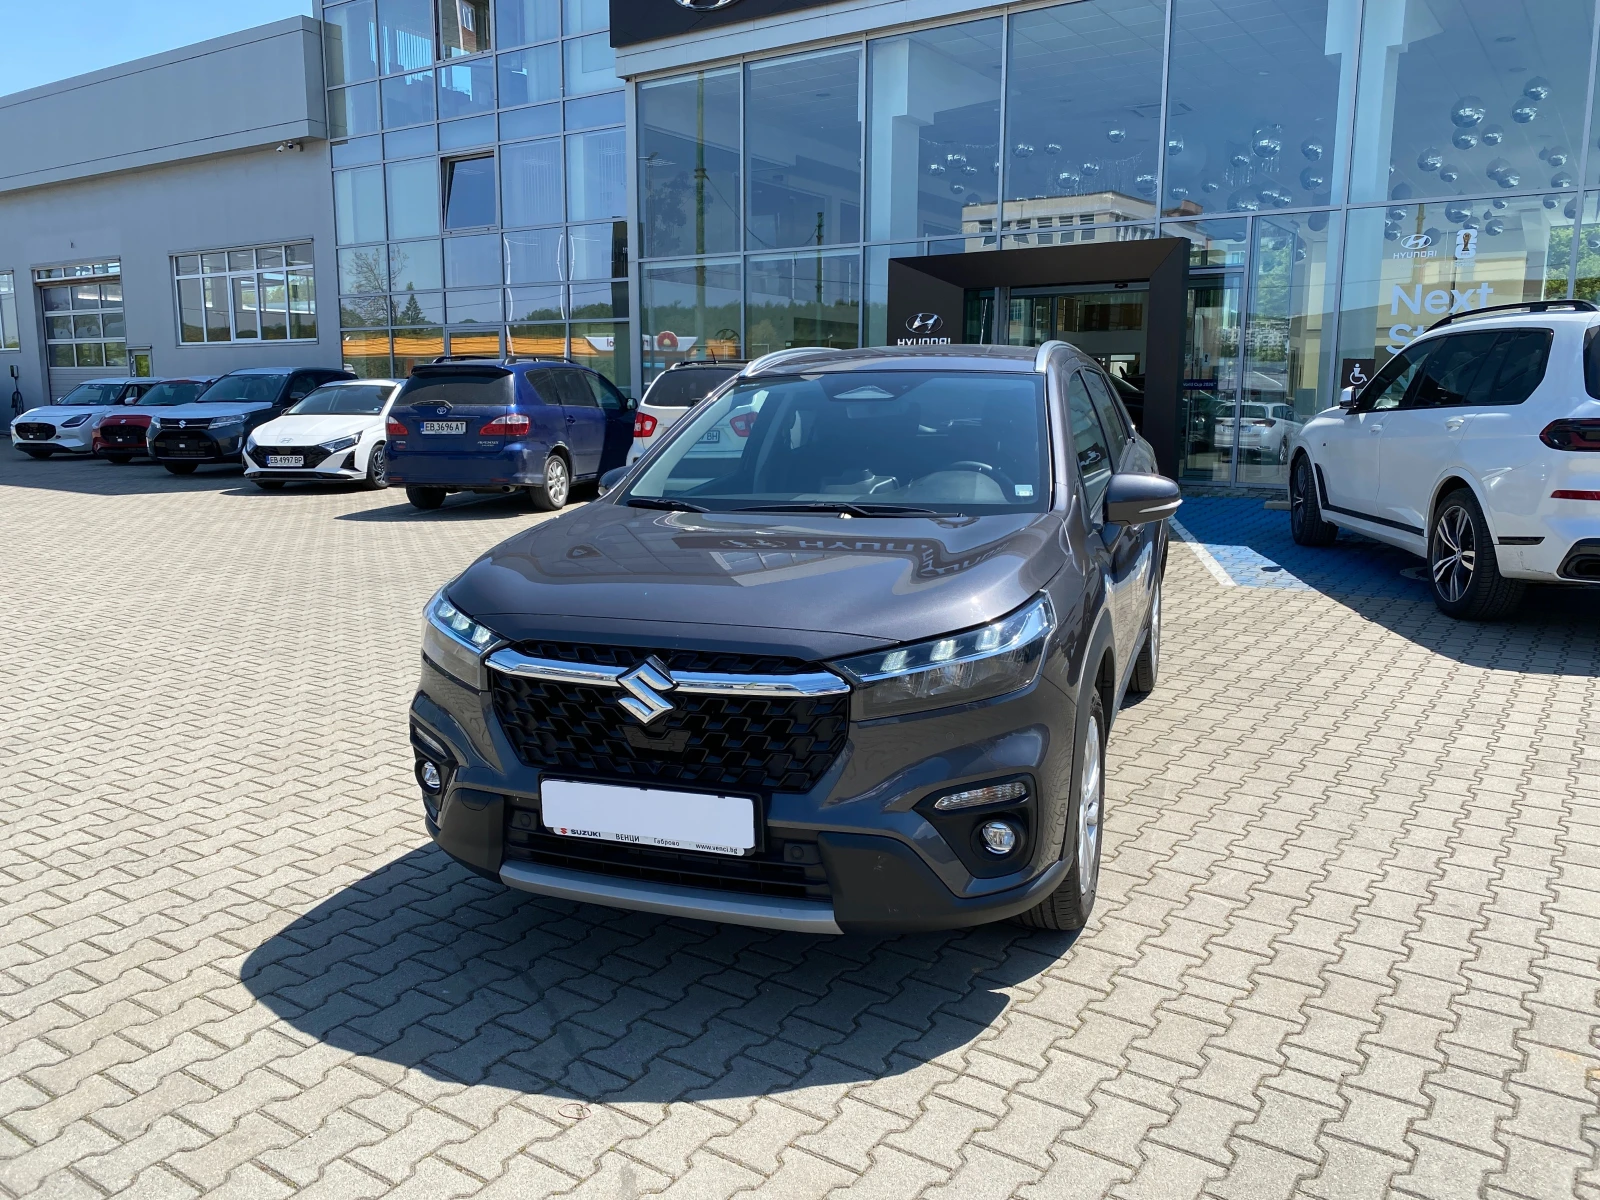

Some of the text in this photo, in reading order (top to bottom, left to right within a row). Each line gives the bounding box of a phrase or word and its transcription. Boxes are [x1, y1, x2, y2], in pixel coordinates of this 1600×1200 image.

[1393, 250, 1437, 259] HYUNDAI
[1390, 282, 1494, 315] Next
[436, 422, 454, 432] 3696
[455, 422, 465, 431] AT
[270, 456, 303, 464] EB 4997 BP
[570, 828, 738, 854] SUZUKI ВЕНЦИ Габрово www.venci.bg
